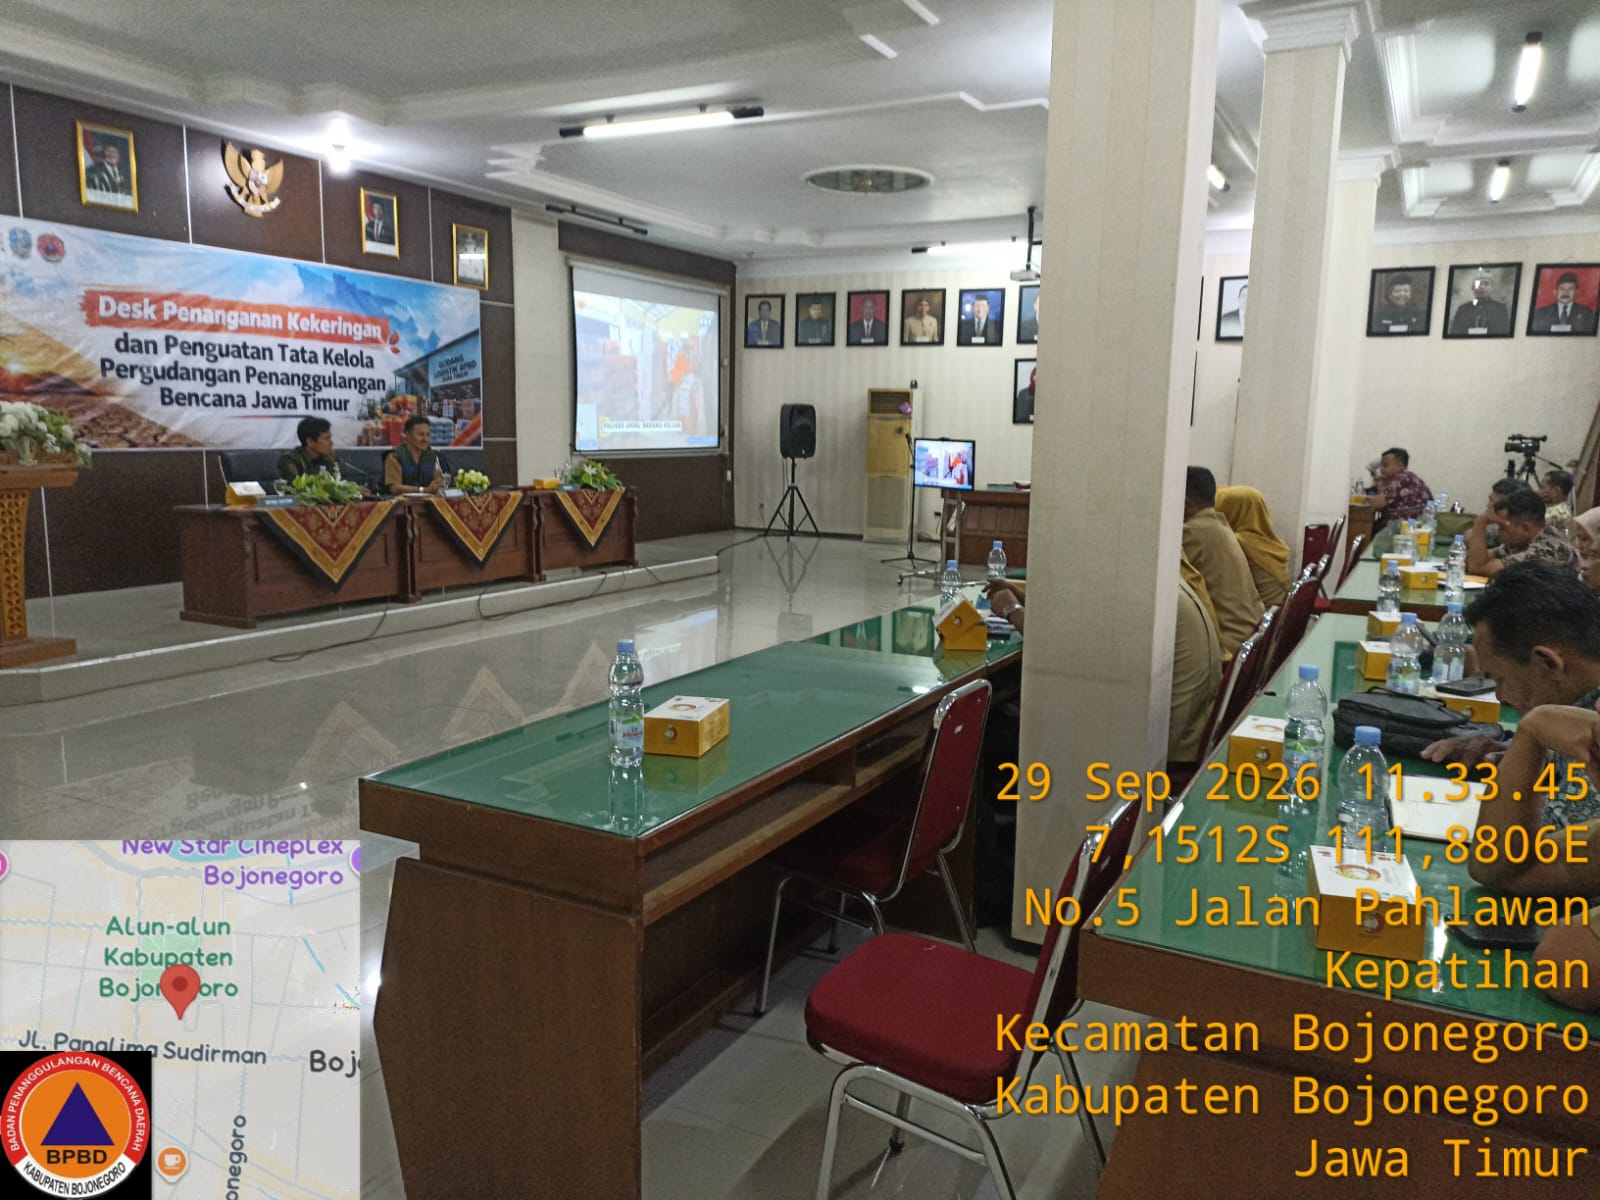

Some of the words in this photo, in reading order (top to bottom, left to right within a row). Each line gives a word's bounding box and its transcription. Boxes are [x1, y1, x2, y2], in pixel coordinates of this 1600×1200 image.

[98, 295, 157, 320] Desk
[163, 300, 283, 331] Penanganan
[287, 311, 382, 341] Kekeringan
[114, 331, 158, 355] dan
[164, 334, 274, 363] Penguatan
[277, 343, 319, 364] Tata
[322, 347, 375, 369] Kelola
[100, 357, 241, 387] Pergudangan
[245, 365, 387, 395] Penanggulangan
[160, 386, 247, 408] Bencana
[251, 390, 298, 410] Jawa
[301, 392, 350, 411] Timur
